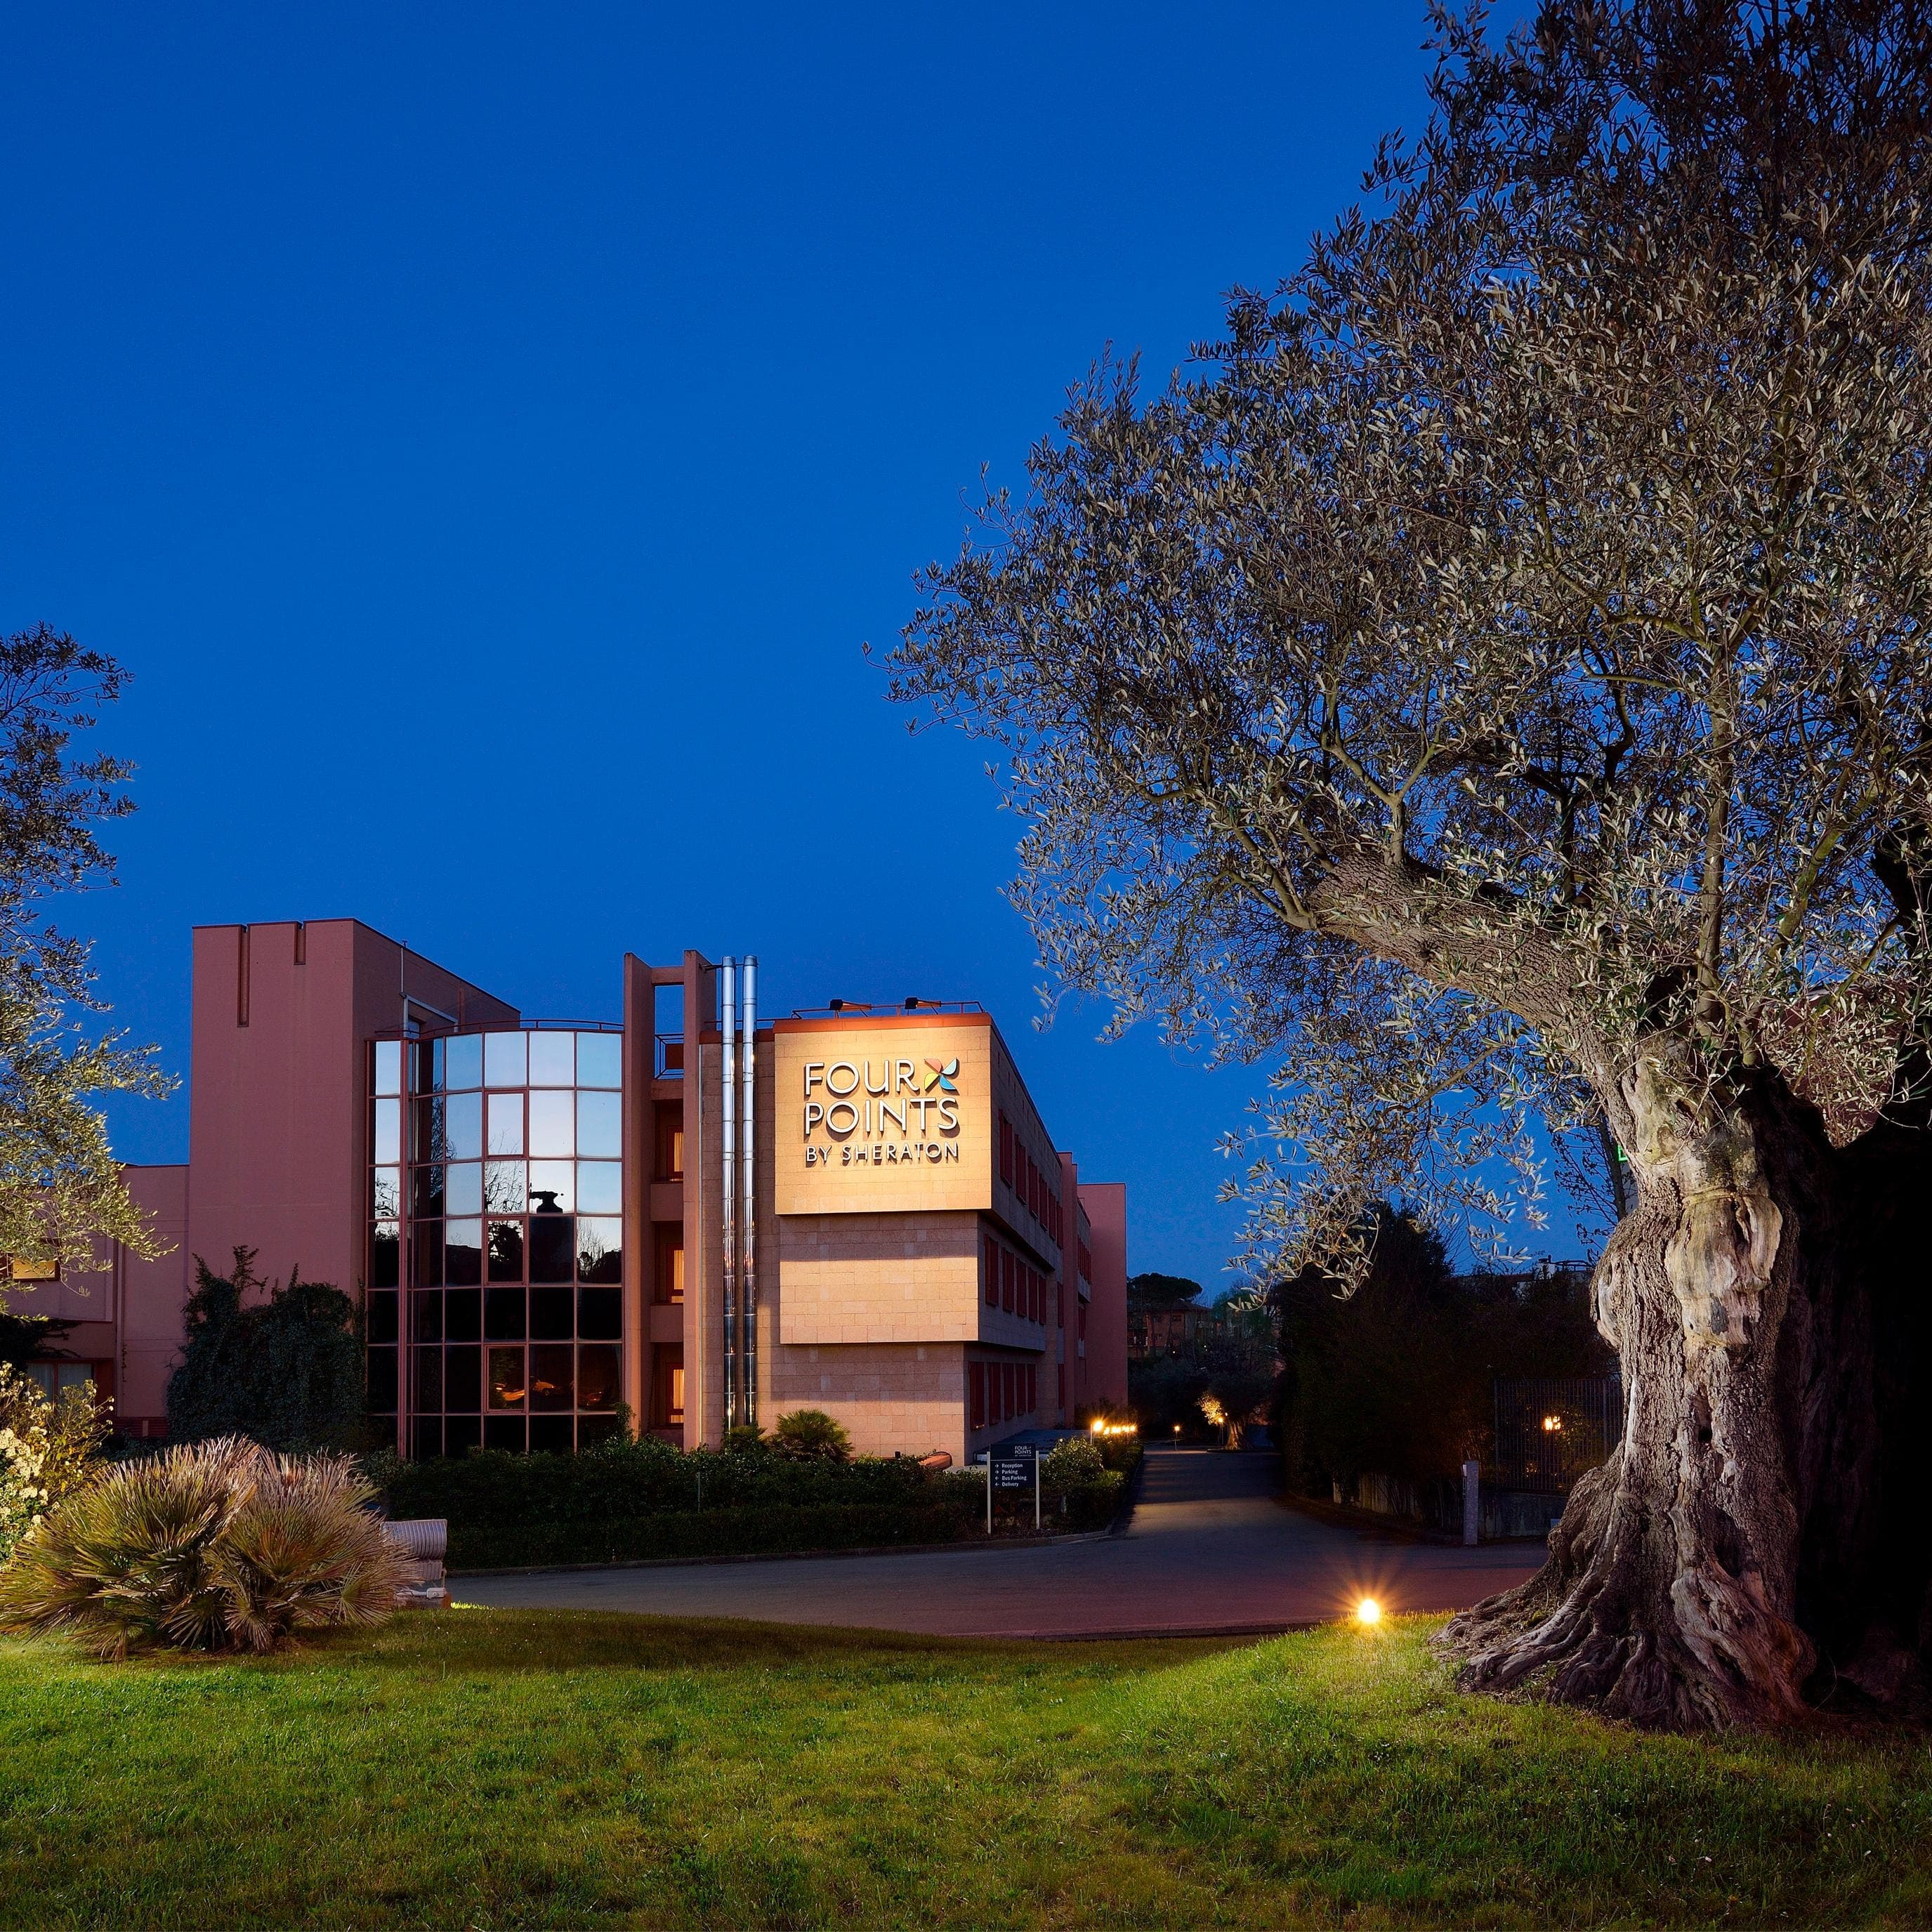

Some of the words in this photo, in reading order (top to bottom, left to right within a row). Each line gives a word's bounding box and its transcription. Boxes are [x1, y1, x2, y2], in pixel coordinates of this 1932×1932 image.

[805, 1059, 920, 1096] FOUR
[805, 1097, 958, 1135] POINTS
[806, 1145, 832, 1162] BY
[842, 1141, 958, 1162] SHERATON
